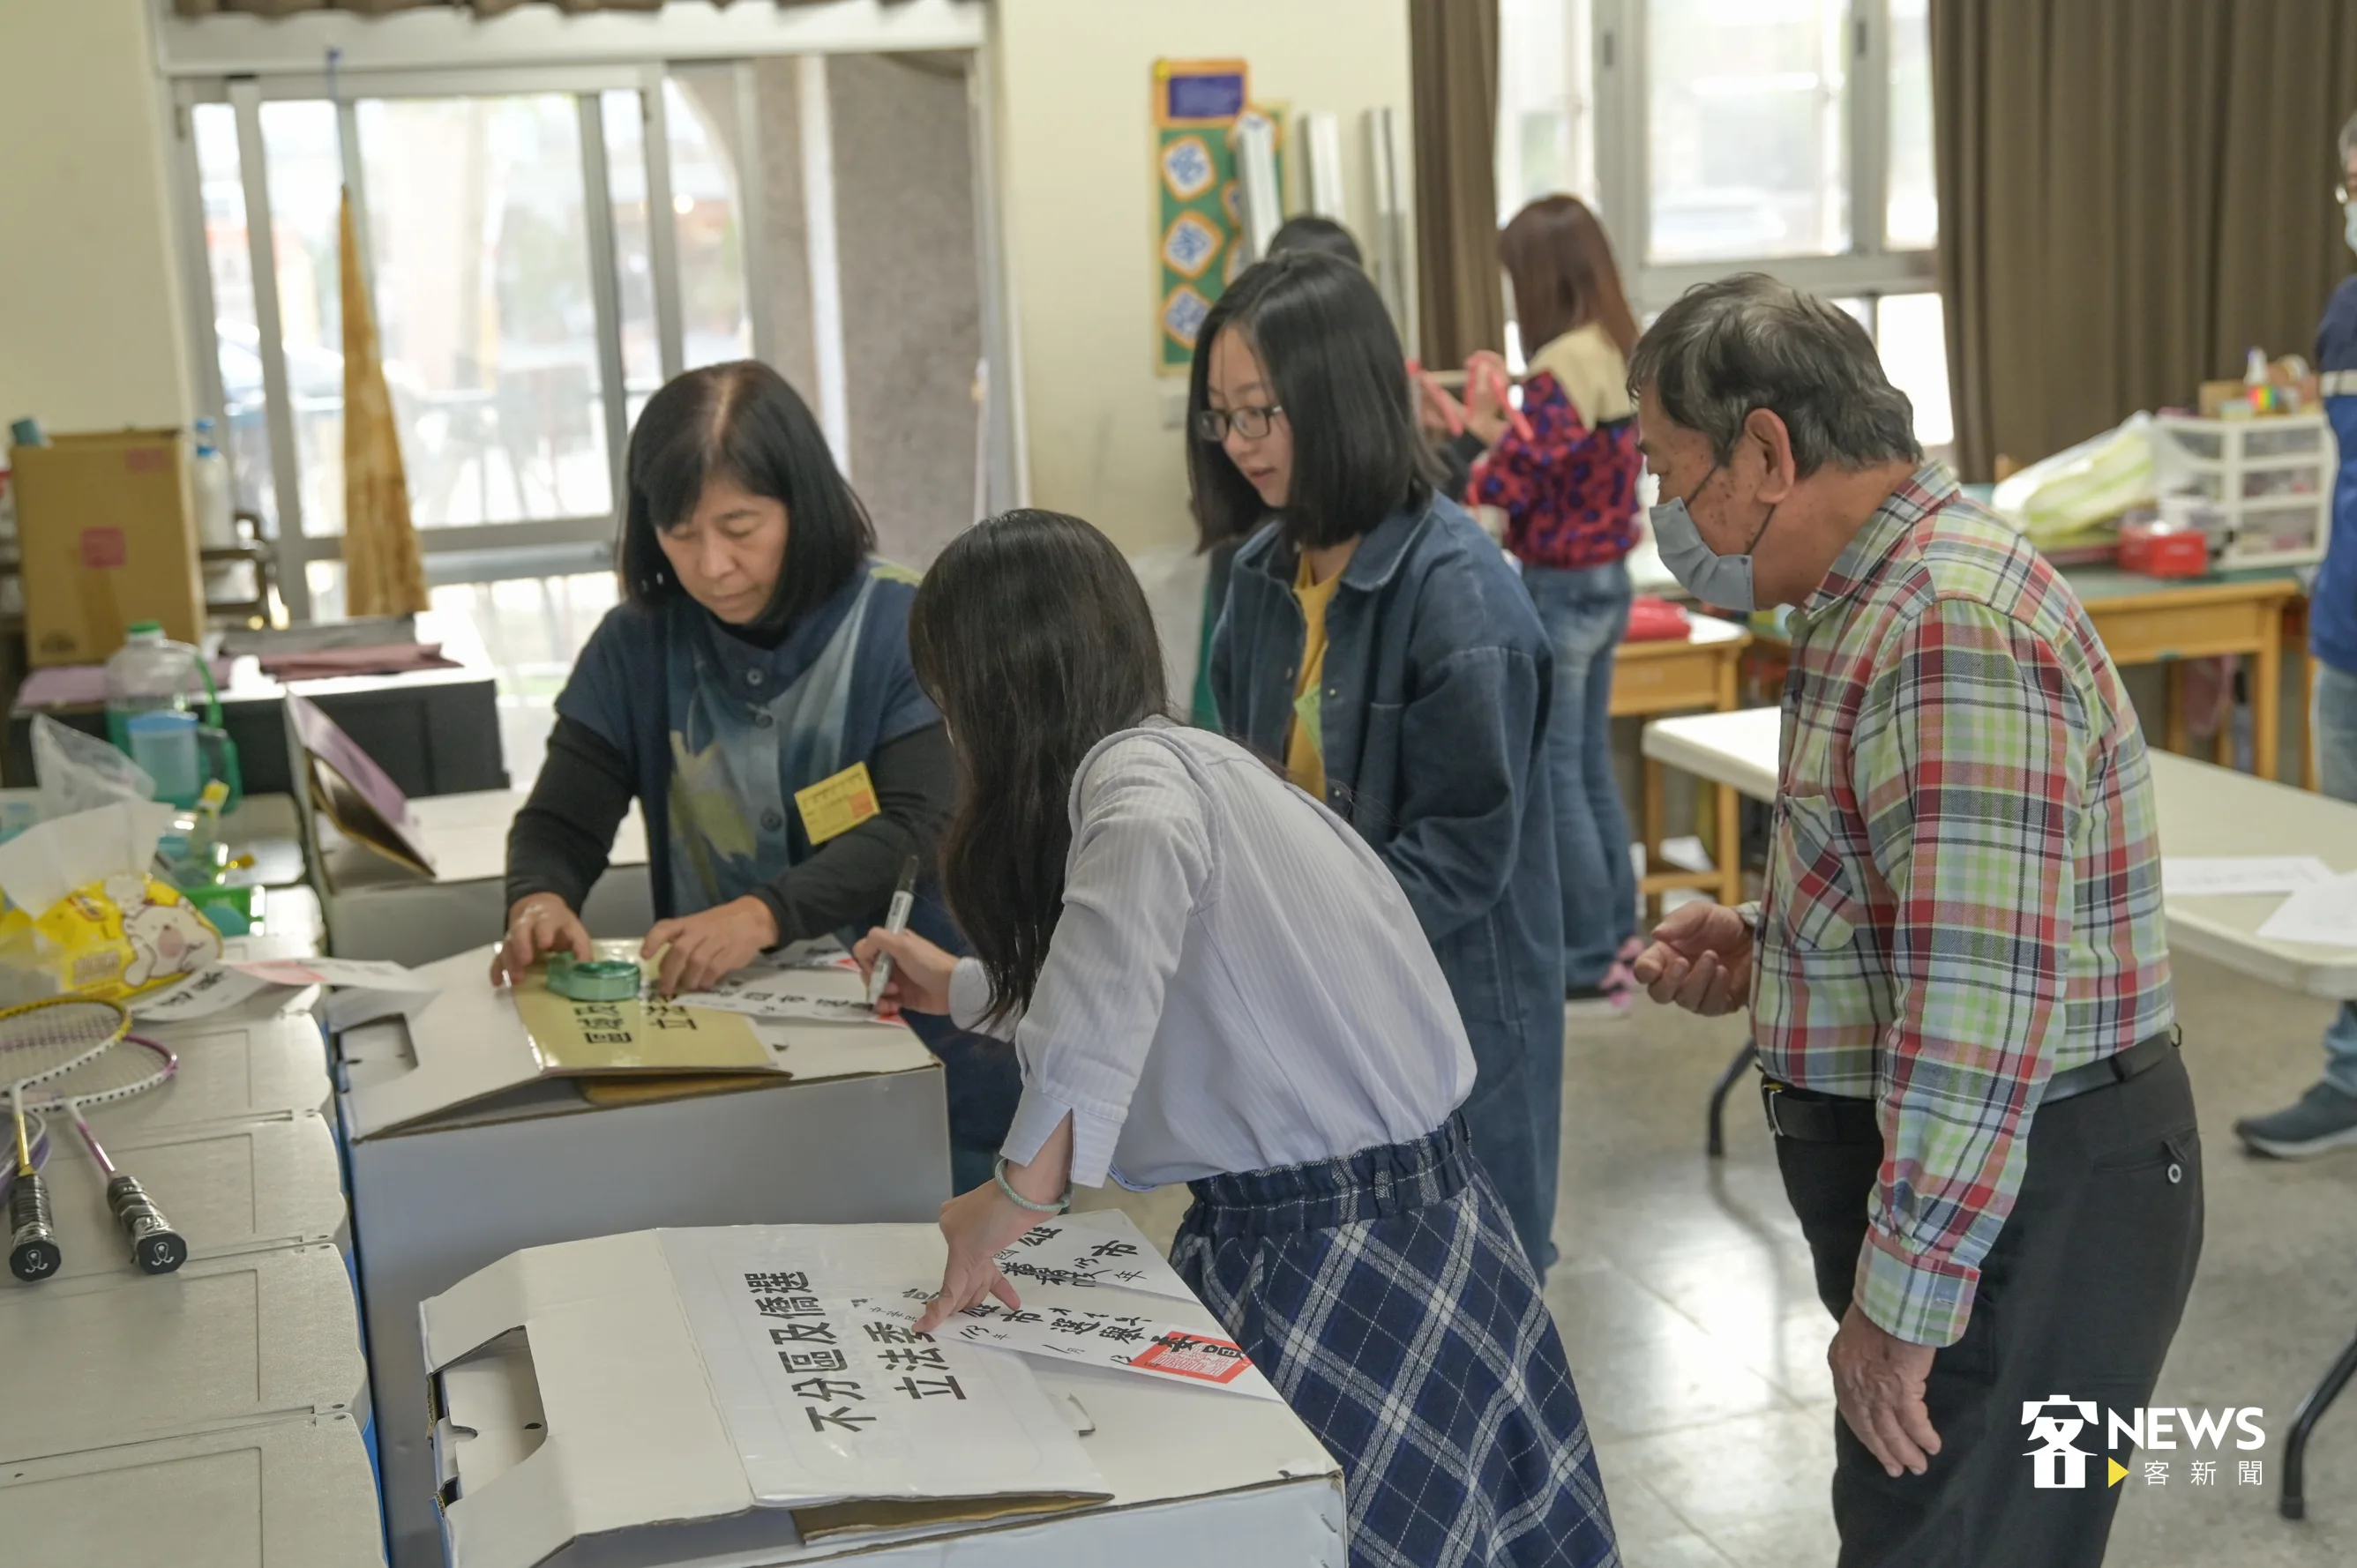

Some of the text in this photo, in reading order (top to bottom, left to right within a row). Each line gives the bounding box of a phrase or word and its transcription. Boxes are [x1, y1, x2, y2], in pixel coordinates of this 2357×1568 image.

[744, 1271, 877, 1433] 不分區及僑選
[850, 1298, 968, 1400] 立法委
